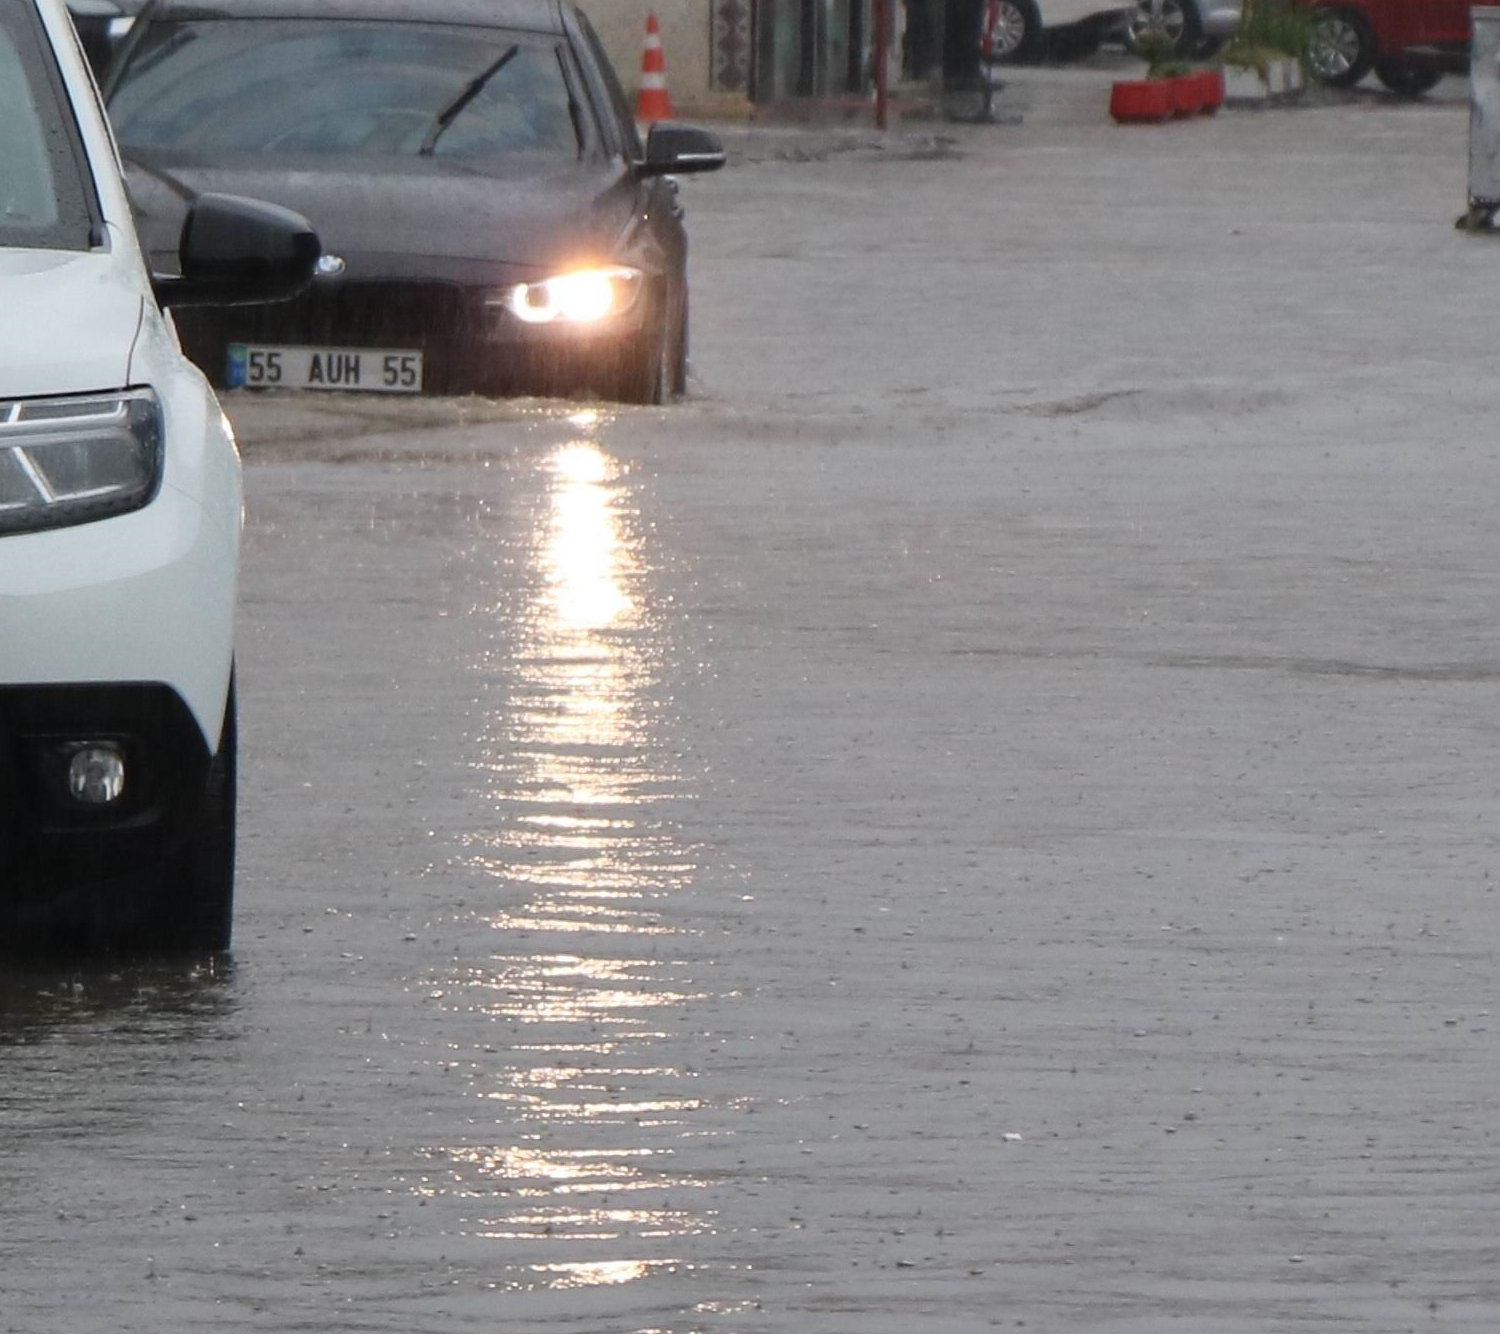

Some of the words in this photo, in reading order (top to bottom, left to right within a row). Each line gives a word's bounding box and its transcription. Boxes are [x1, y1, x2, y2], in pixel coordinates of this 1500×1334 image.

[250, 351, 282, 383] 55
[308, 353, 360, 385] AUH
[383, 355, 417, 387] 55
